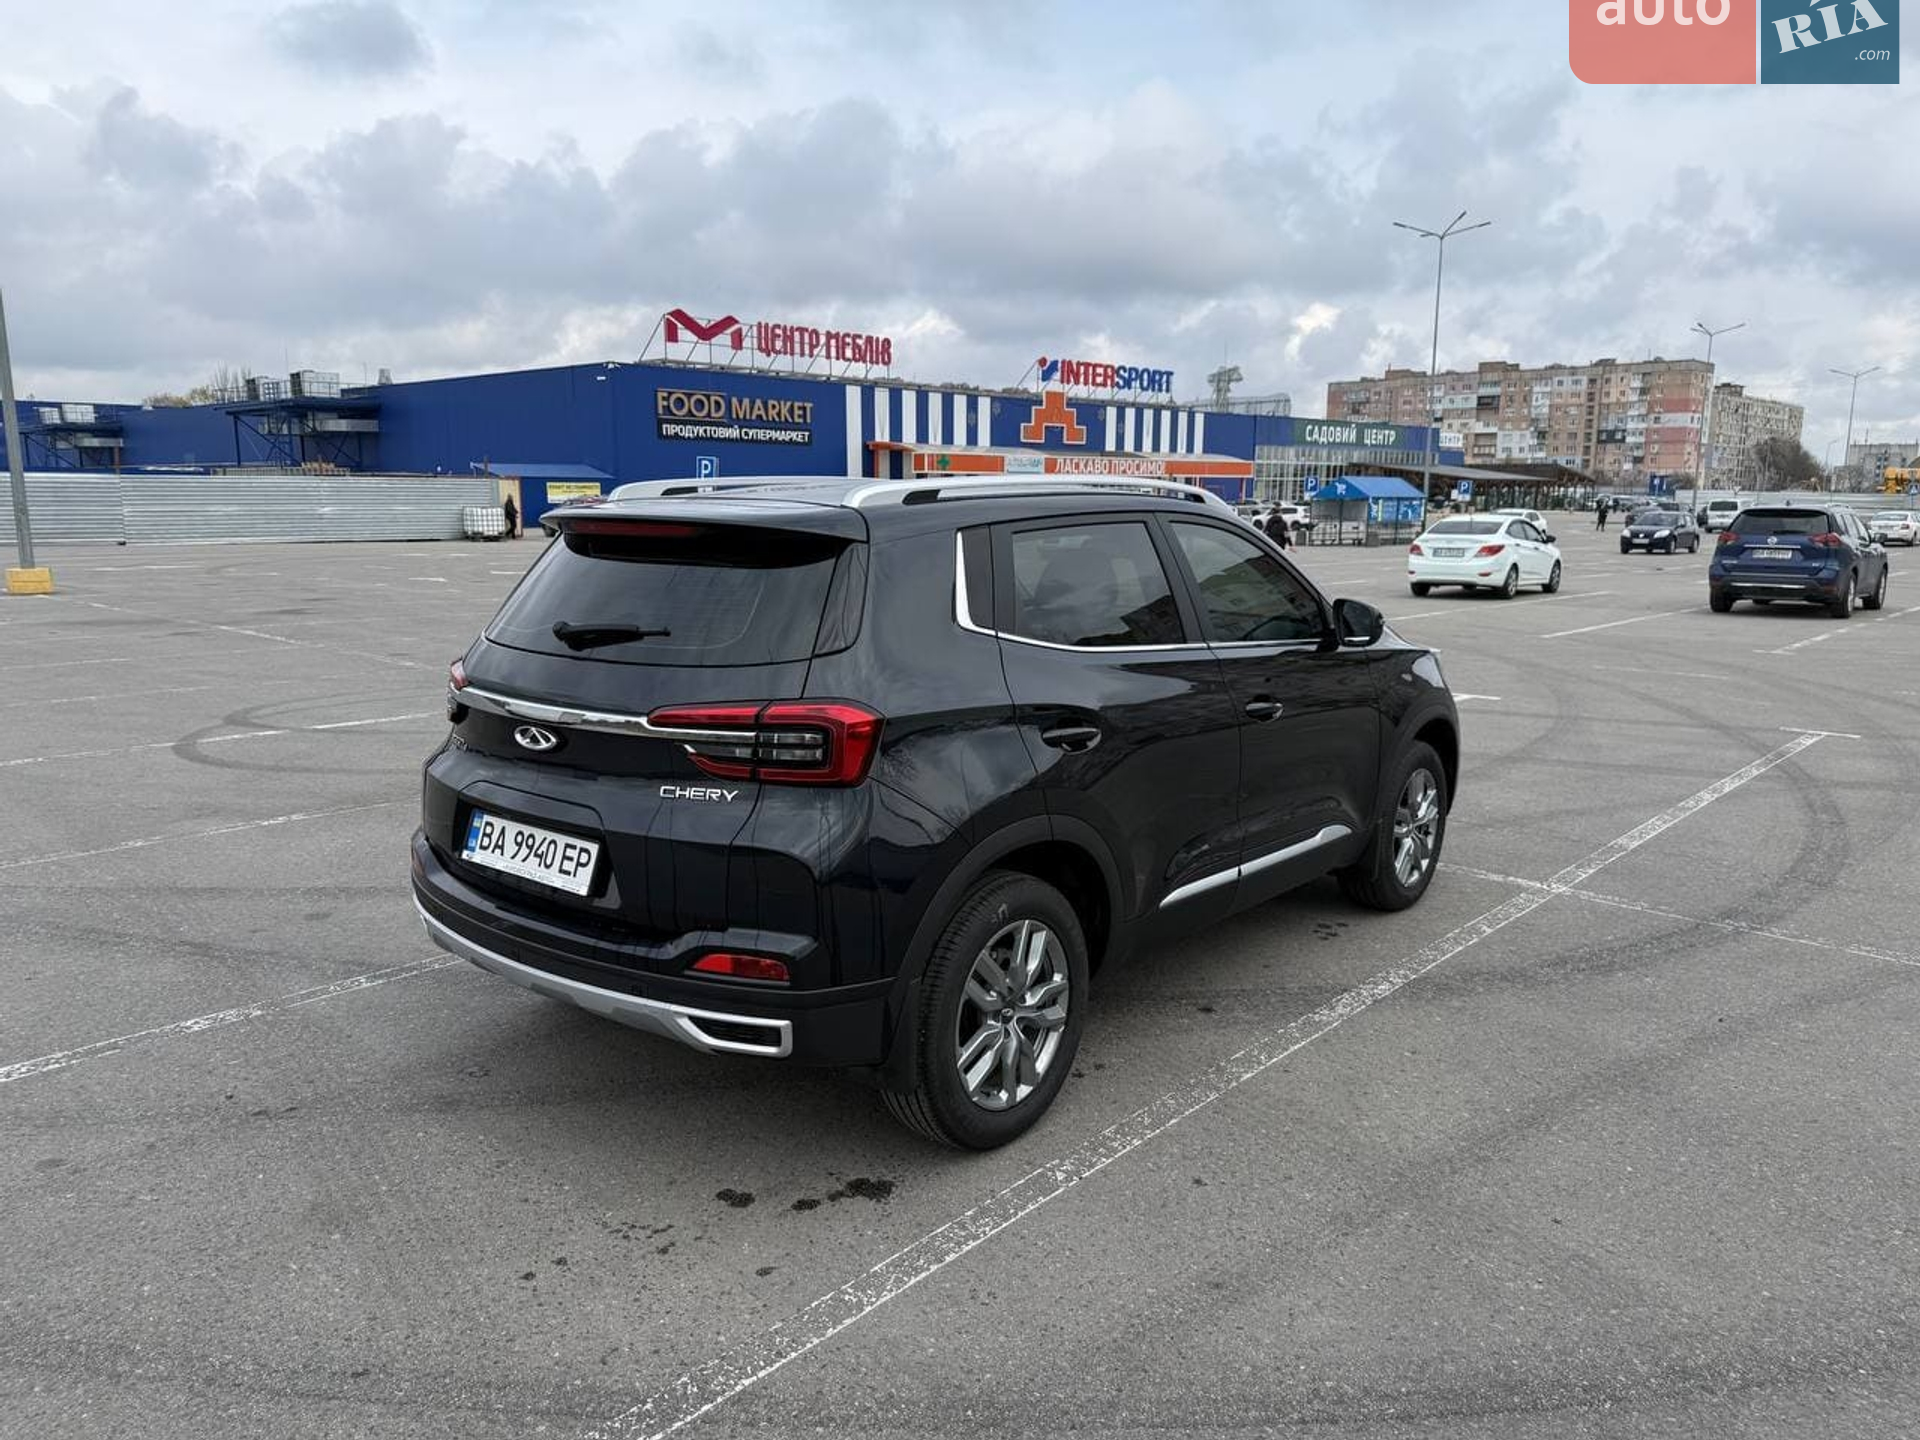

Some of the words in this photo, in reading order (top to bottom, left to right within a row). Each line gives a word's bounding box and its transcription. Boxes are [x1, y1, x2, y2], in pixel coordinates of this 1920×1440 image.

[756, 321, 820, 357] ЦЕНТР
[825, 329, 893, 366] МЕБЛІВ
[1060, 359, 1174, 393] INTERSPORT
[656, 391, 726, 420] FOOD
[731, 396, 814, 423] MARKET
[662, 422, 740, 440] ПРОДУКТОВИЙ
[741, 426, 810, 443] СУПЕРМАРКЕТ
[1305, 423, 1357, 444] САДОВИЙ
[1363, 427, 1397, 448] ЦЕНТР
[1054, 458, 1109, 475] ЛАСКАВО
[660, 784, 739, 803] CHERY
[478, 820, 506, 857] BA
[510, 830, 558, 870] 9940
[558, 843, 592, 878] EP
